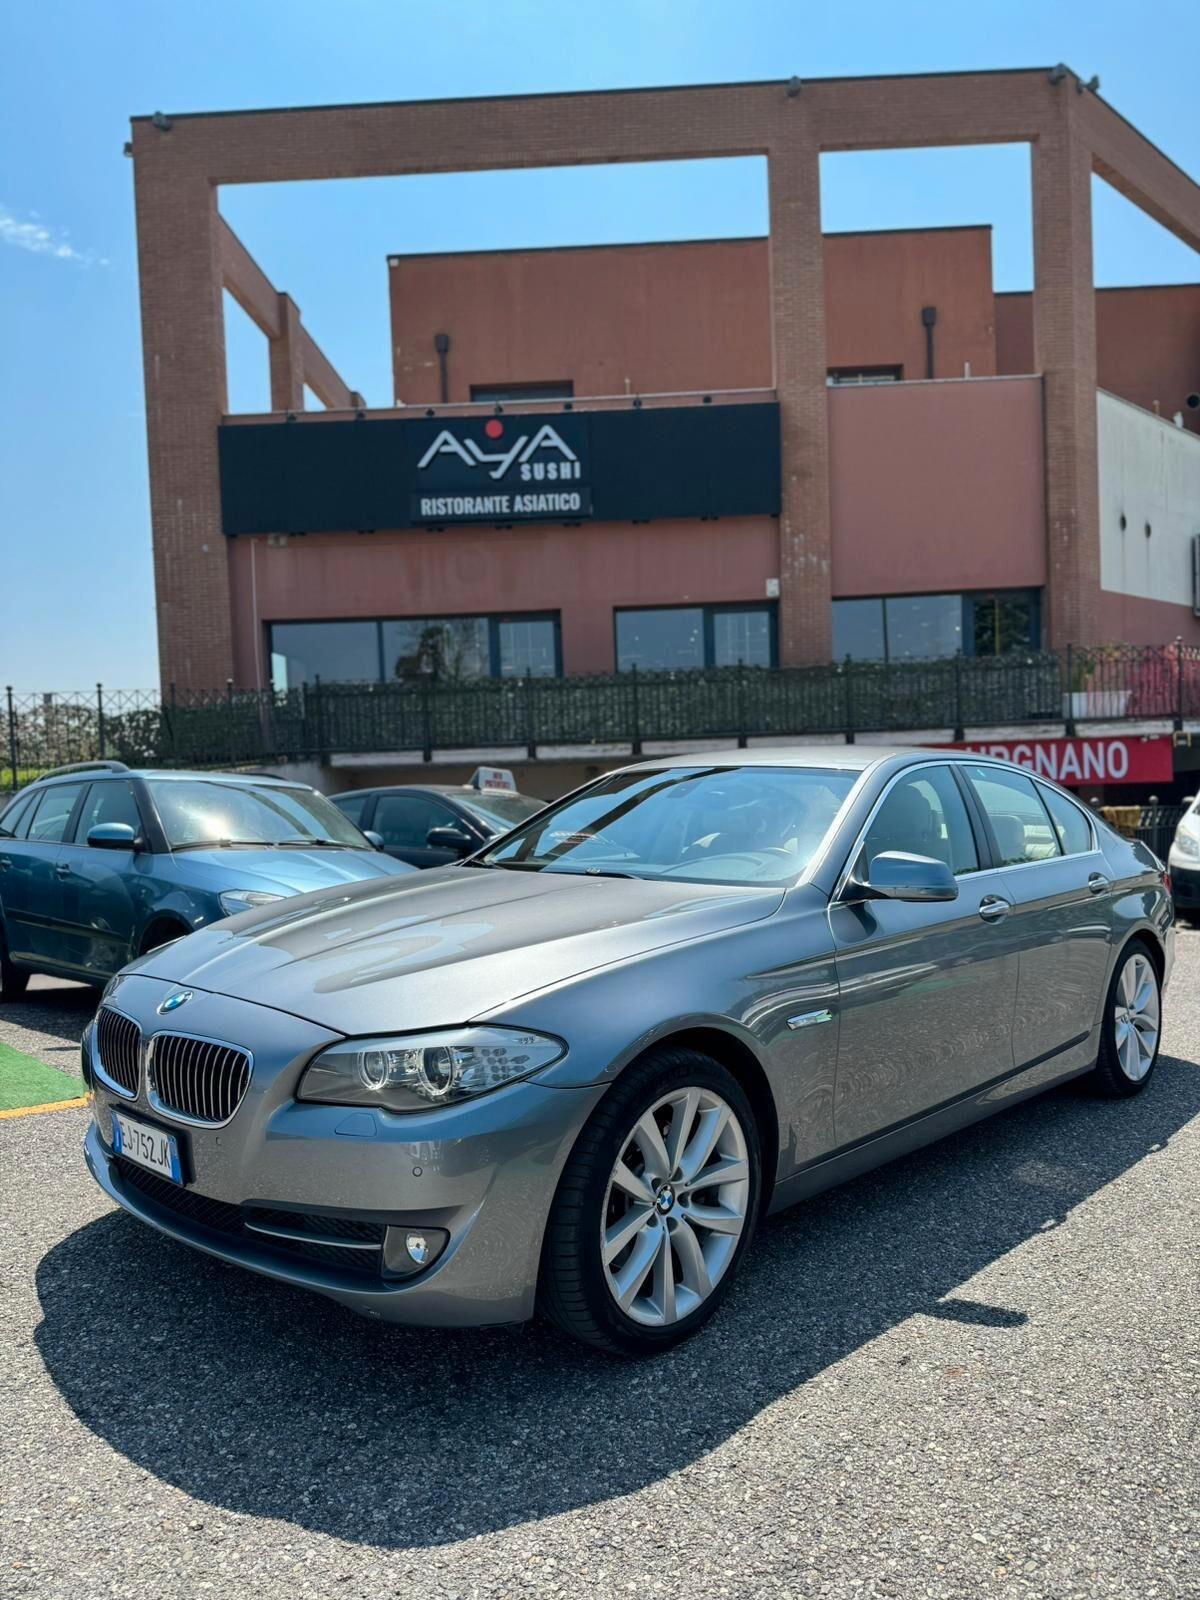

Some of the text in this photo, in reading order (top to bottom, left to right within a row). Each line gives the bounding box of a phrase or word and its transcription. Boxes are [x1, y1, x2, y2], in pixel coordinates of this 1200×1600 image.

[520, 461, 581, 481] SUSHI
[420, 492, 581, 516] RISTORANTE ASIATICO
[966, 741, 1130, 781] GNANO
